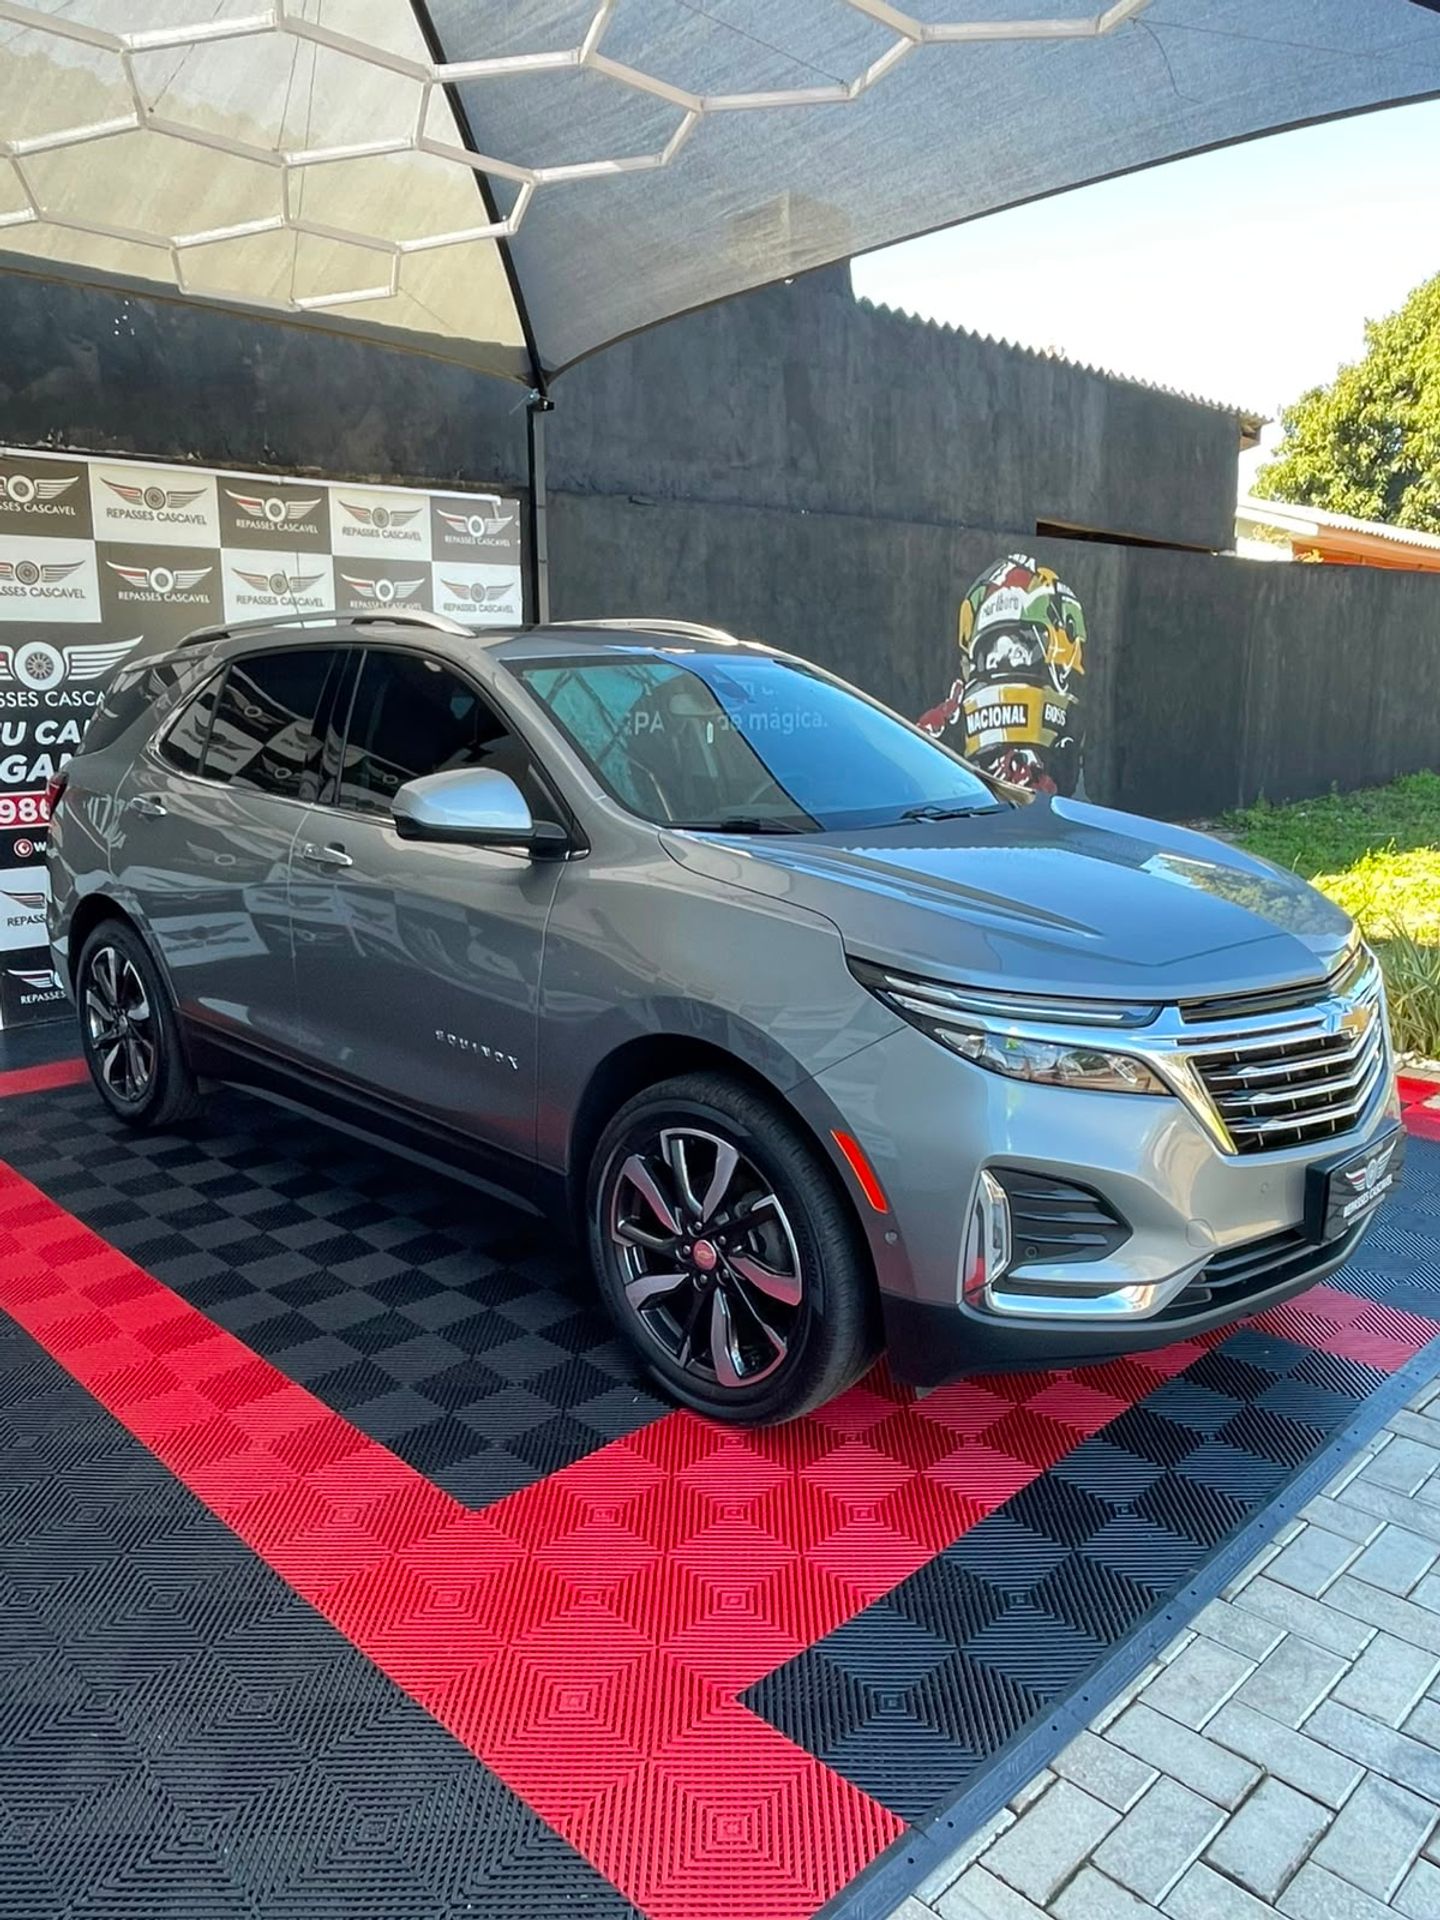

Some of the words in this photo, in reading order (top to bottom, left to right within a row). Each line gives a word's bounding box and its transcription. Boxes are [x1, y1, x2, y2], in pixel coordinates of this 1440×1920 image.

[0, 501, 20, 512] SSES
[23, 503, 76, 516] CASCAVEL
[106, 507, 154, 521] REPASSES
[157, 511, 207, 525] CASCAVEL
[236, 518, 275, 531] REPASSES
[277, 521, 318, 534] CASCAVEL
[342, 526, 380, 538] REPASSES
[382, 530, 421, 542] CASCAVEL
[444, 535, 476, 545] REPASSES
[477, 537, 511, 548] CASCAVEL
[29, 586, 87, 600] CASCAVEL
[118, 591, 161, 602] REPASSES
[163, 592, 210, 604] CASCAVEL
[236, 594, 279, 606] REPASSES
[280, 596, 325, 608] CASCAVEL
[443, 602, 477, 613] REPASSES
[478, 603, 514, 614] CASCAVEL
[967, 704, 1026, 735] NACIONAL
[1045, 703, 1068, 727] BOSS
[0, 721, 27, 747] U
[20, 990, 66, 1005] REPASSES
[435, 1029, 518, 1070] EQUINOX
